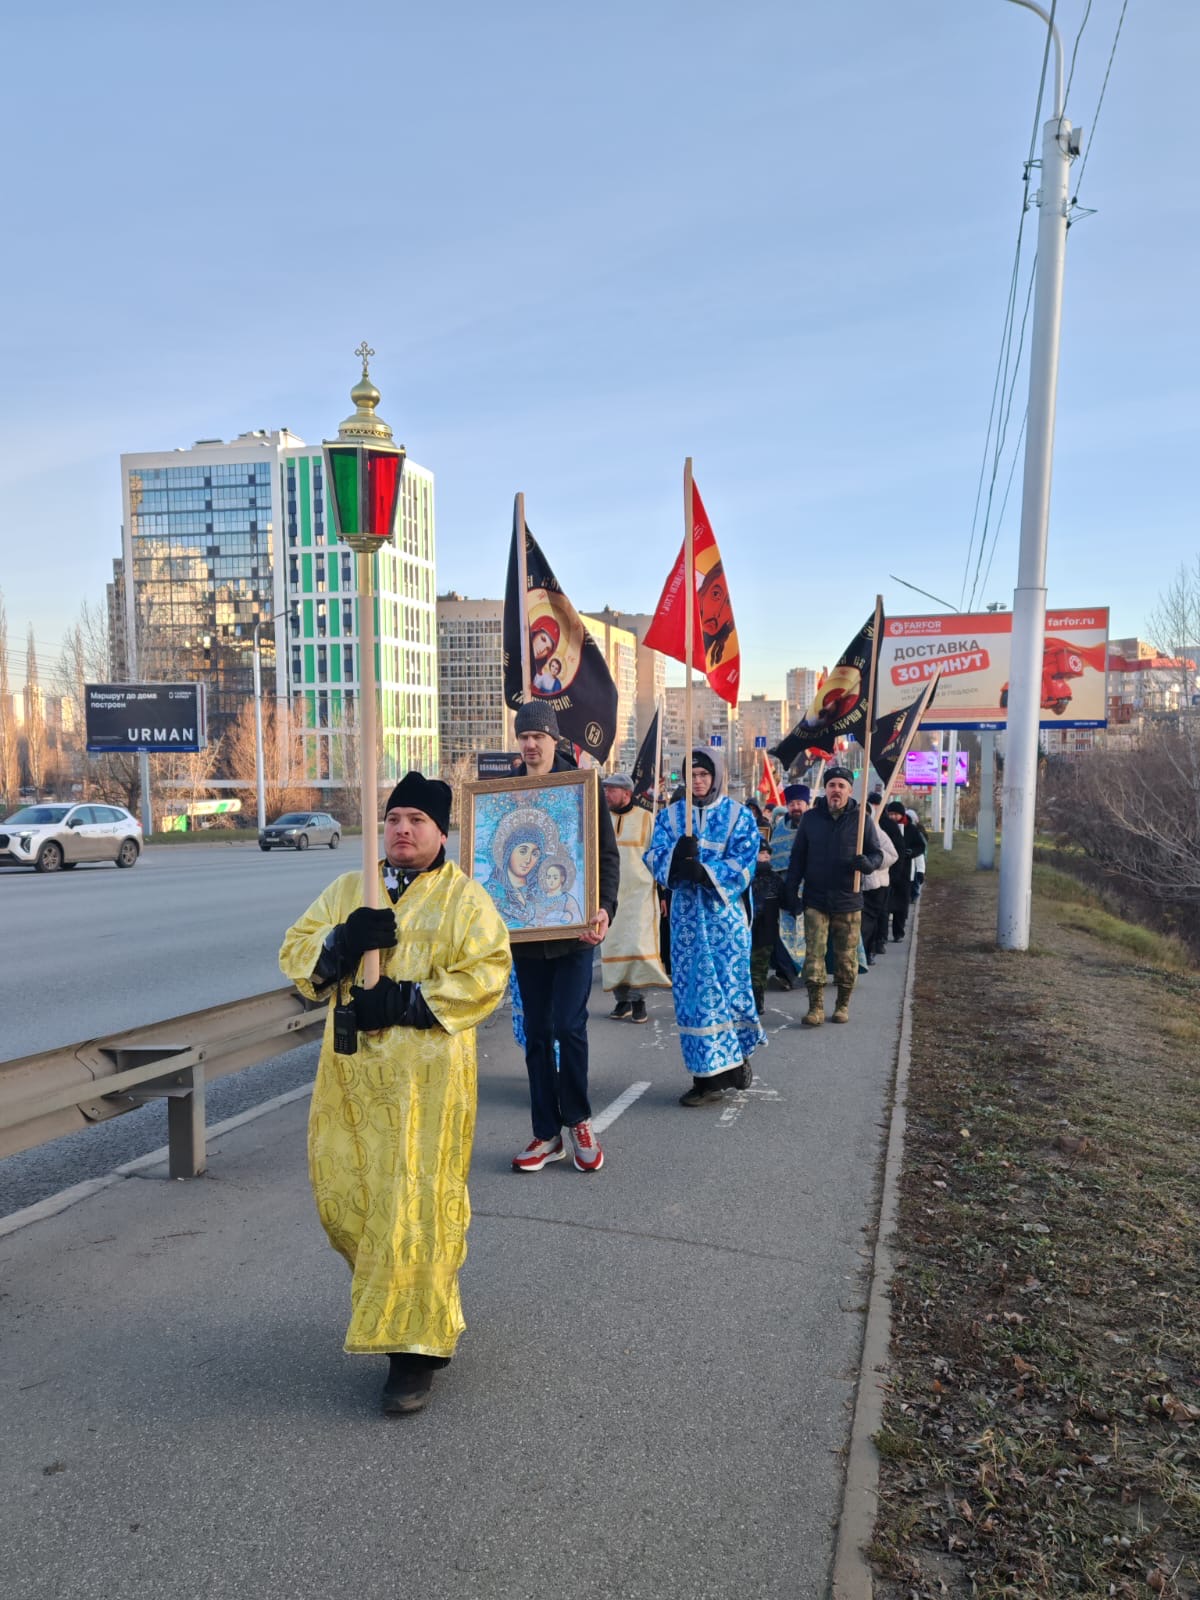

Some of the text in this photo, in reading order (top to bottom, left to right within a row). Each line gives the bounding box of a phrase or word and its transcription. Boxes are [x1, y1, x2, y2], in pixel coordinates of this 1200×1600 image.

[904, 621, 941, 629] FARFOR
[1048, 617, 1095, 627] farfor.ru
[894, 640, 980, 660] ДОСТАВКА
[897, 666, 920, 681] 30
[90, 691, 125, 700] Маршрут
[91, 702, 126, 710] построен
[128, 728, 193, 742] URMAN
